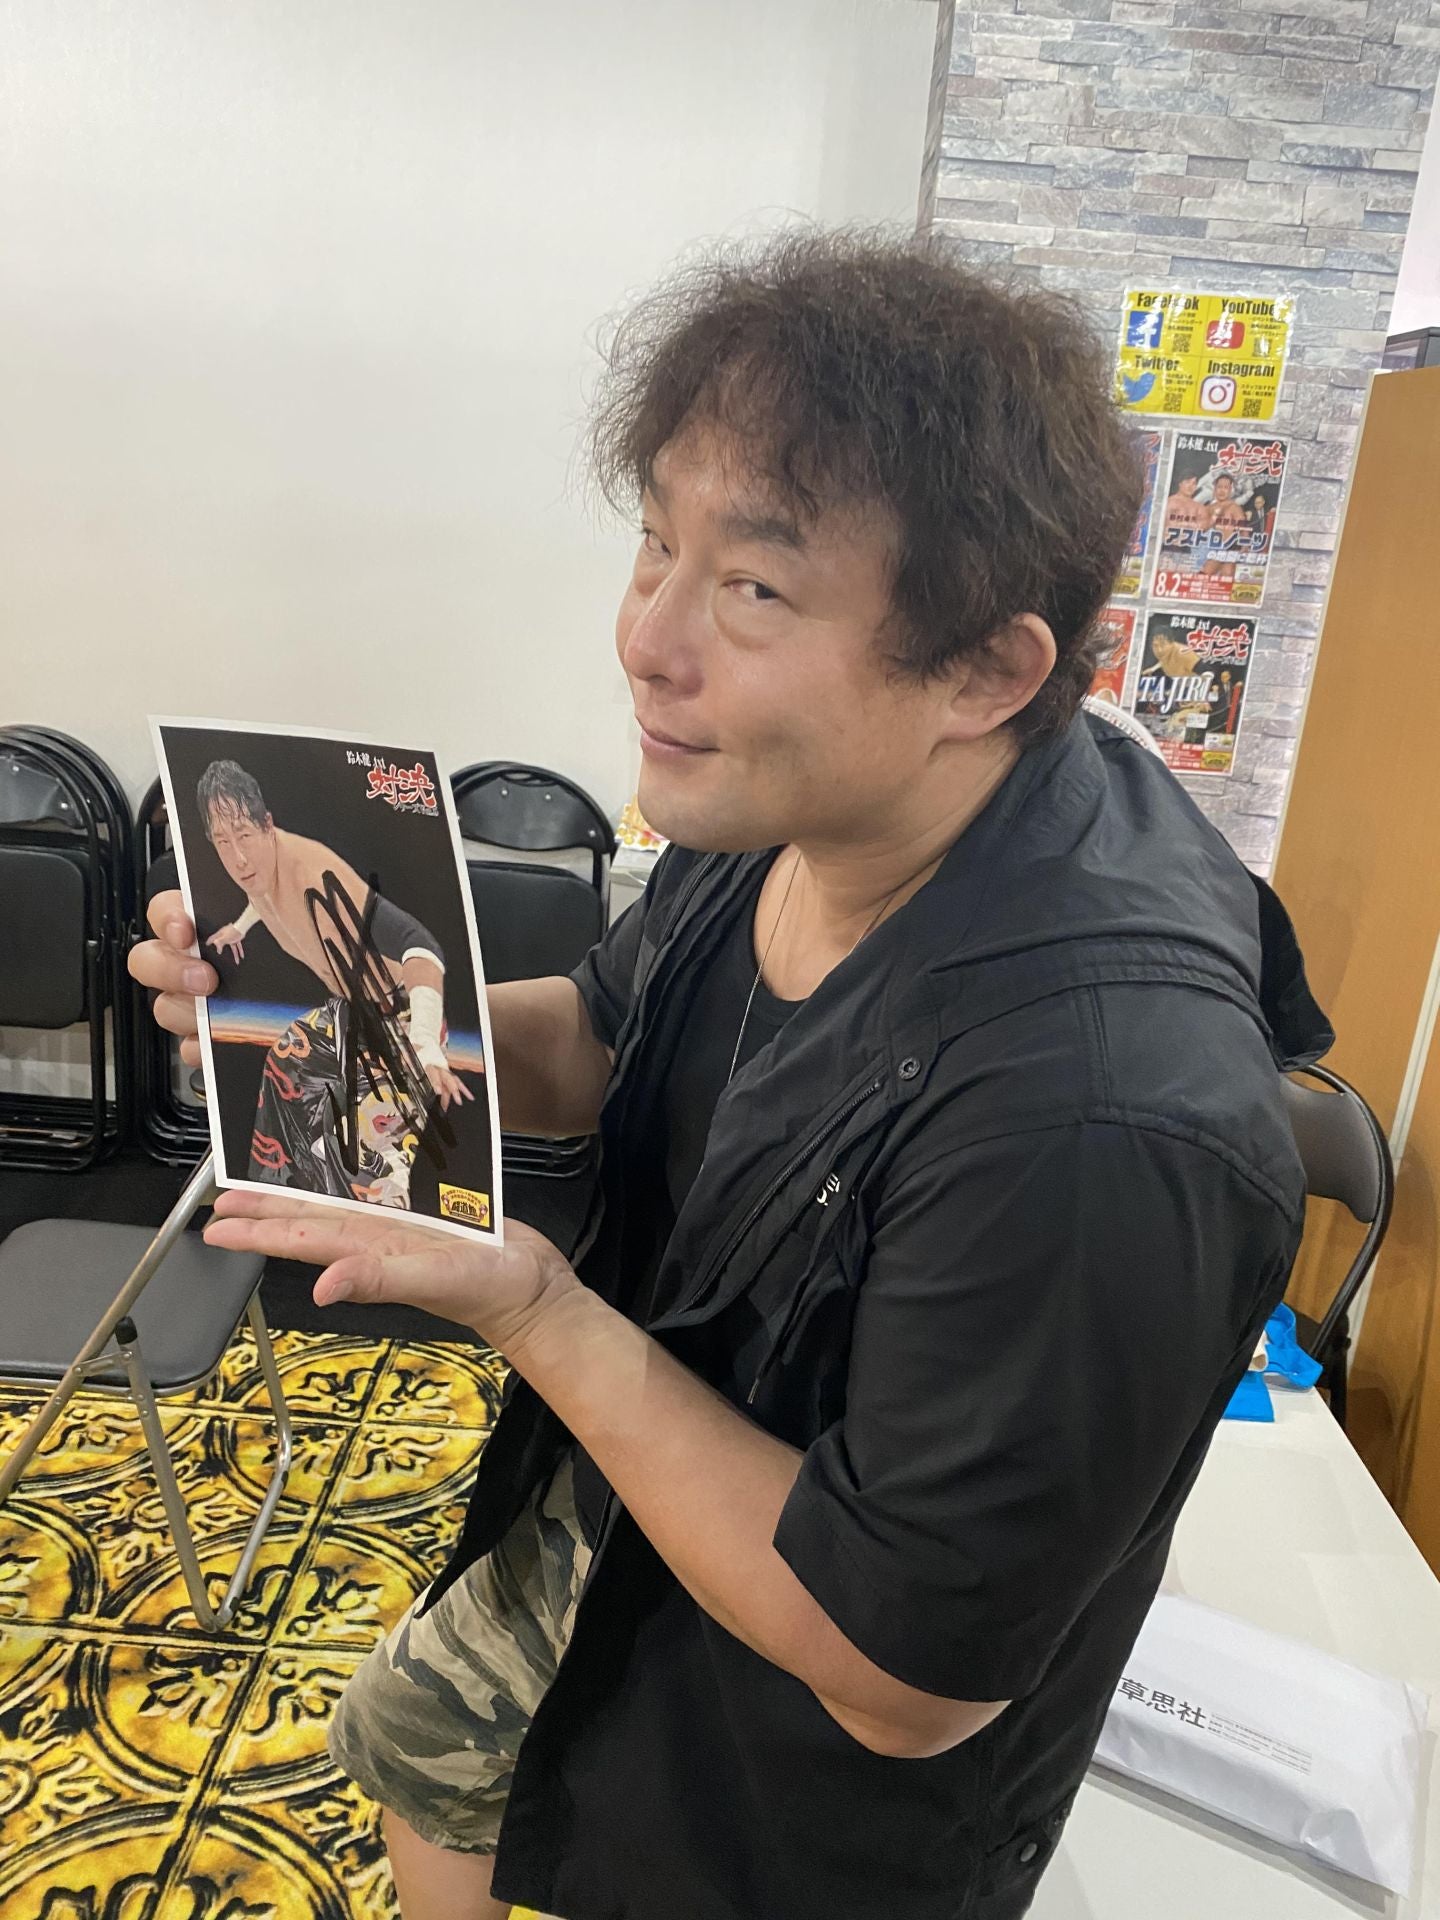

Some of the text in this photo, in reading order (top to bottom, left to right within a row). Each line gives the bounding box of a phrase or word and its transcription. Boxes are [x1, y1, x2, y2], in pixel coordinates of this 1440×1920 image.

[1207, 360, 1275, 378] Instagram
[1165, 527, 1269, 552] アストロノーツ
[1155, 572, 1181, 598] 8.2
[1138, 676, 1214, 714] TAJIRI
[366, 762, 437, 807] 対決
[1117, 1677, 1206, 1729] 草思社
